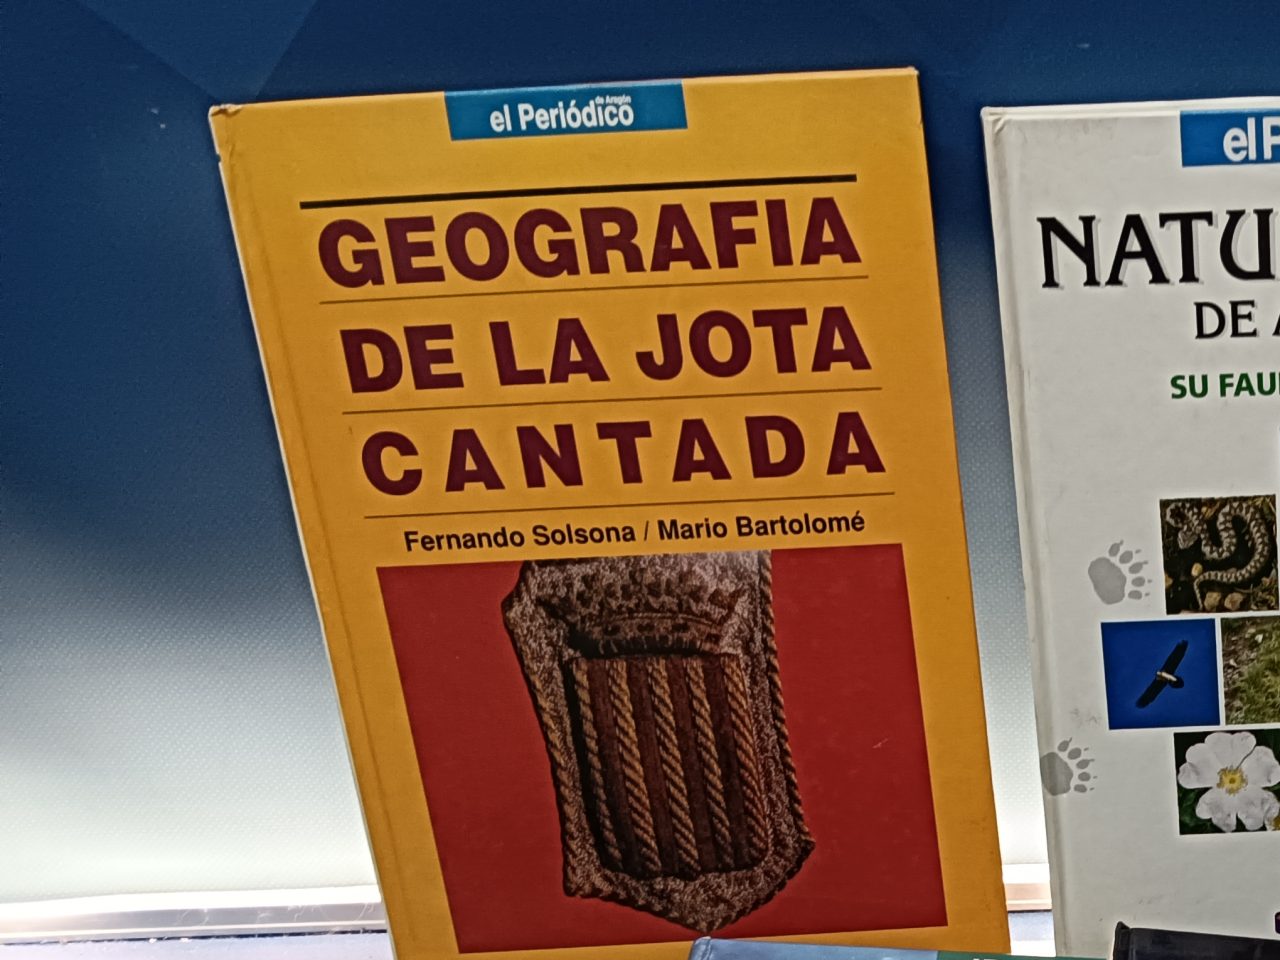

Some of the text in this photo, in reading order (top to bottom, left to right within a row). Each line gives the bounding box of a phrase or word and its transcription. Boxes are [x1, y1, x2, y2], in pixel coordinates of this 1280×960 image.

[518, 99, 634, 131] Periódico
[317, 196, 861, 289] GEOGRAFIA
[1194, 300, 1258, 340] DE
[338, 306, 872, 395] DE LA JOTA
[1170, 373, 1209, 400] SU
[361, 412, 887, 496] CANTADA
[403, 528, 525, 552] Fernando
[533, 523, 636, 546] Solsona
[658, 516, 728, 541] Mario
[736, 511, 866, 537] Bartolomé
